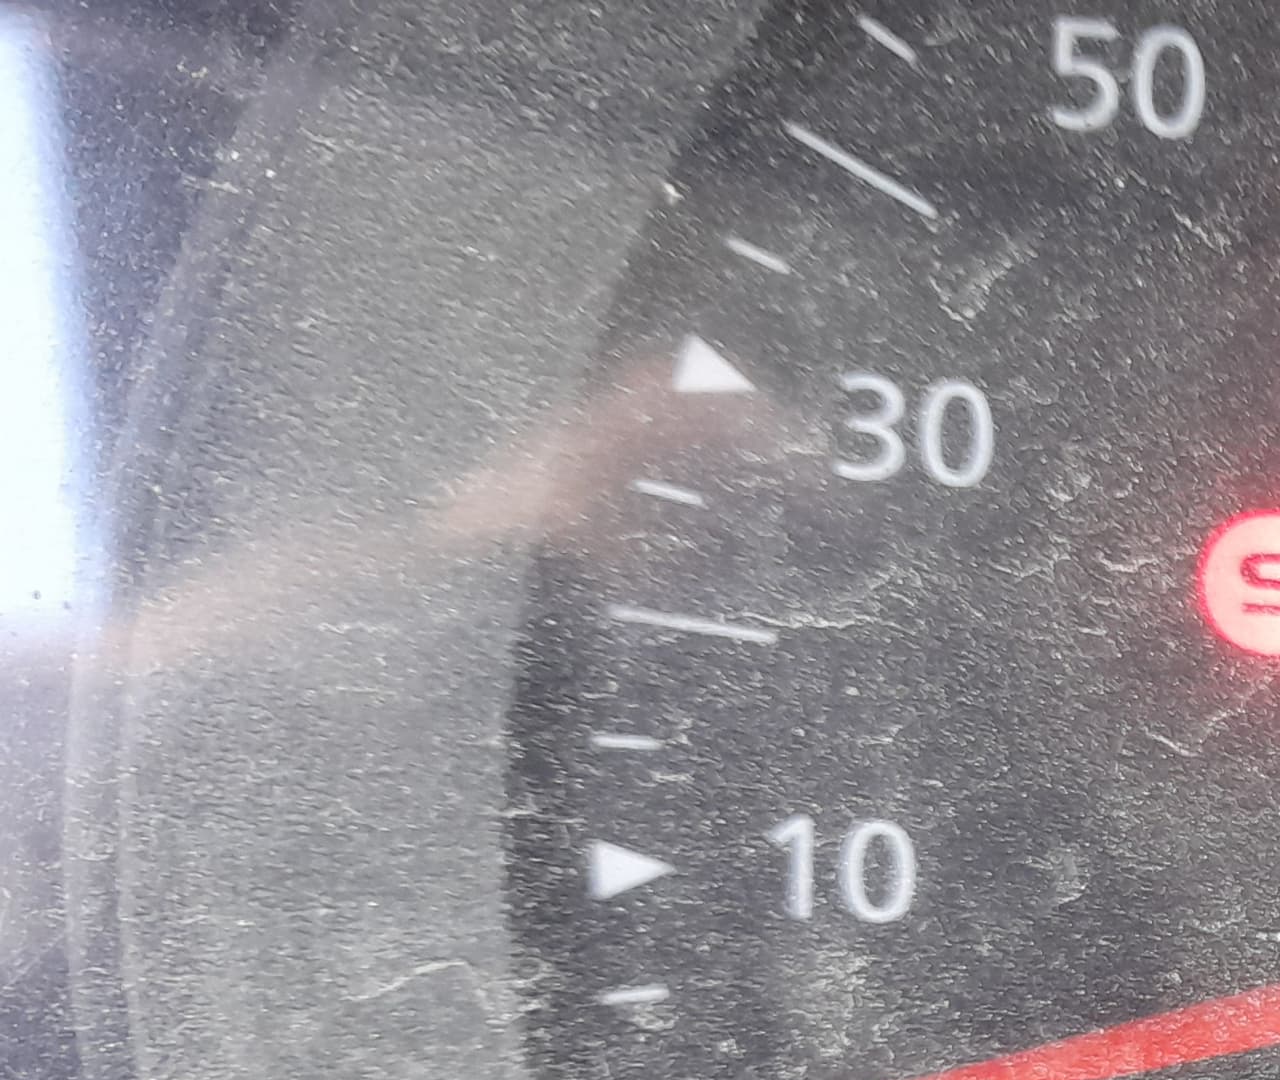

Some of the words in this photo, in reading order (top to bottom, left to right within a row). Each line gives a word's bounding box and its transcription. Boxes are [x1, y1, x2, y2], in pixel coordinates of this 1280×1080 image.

[1050, 15, 1206, 138] 50
[832, 370, 994, 488] 30
[766, 815, 917, 924] 10
